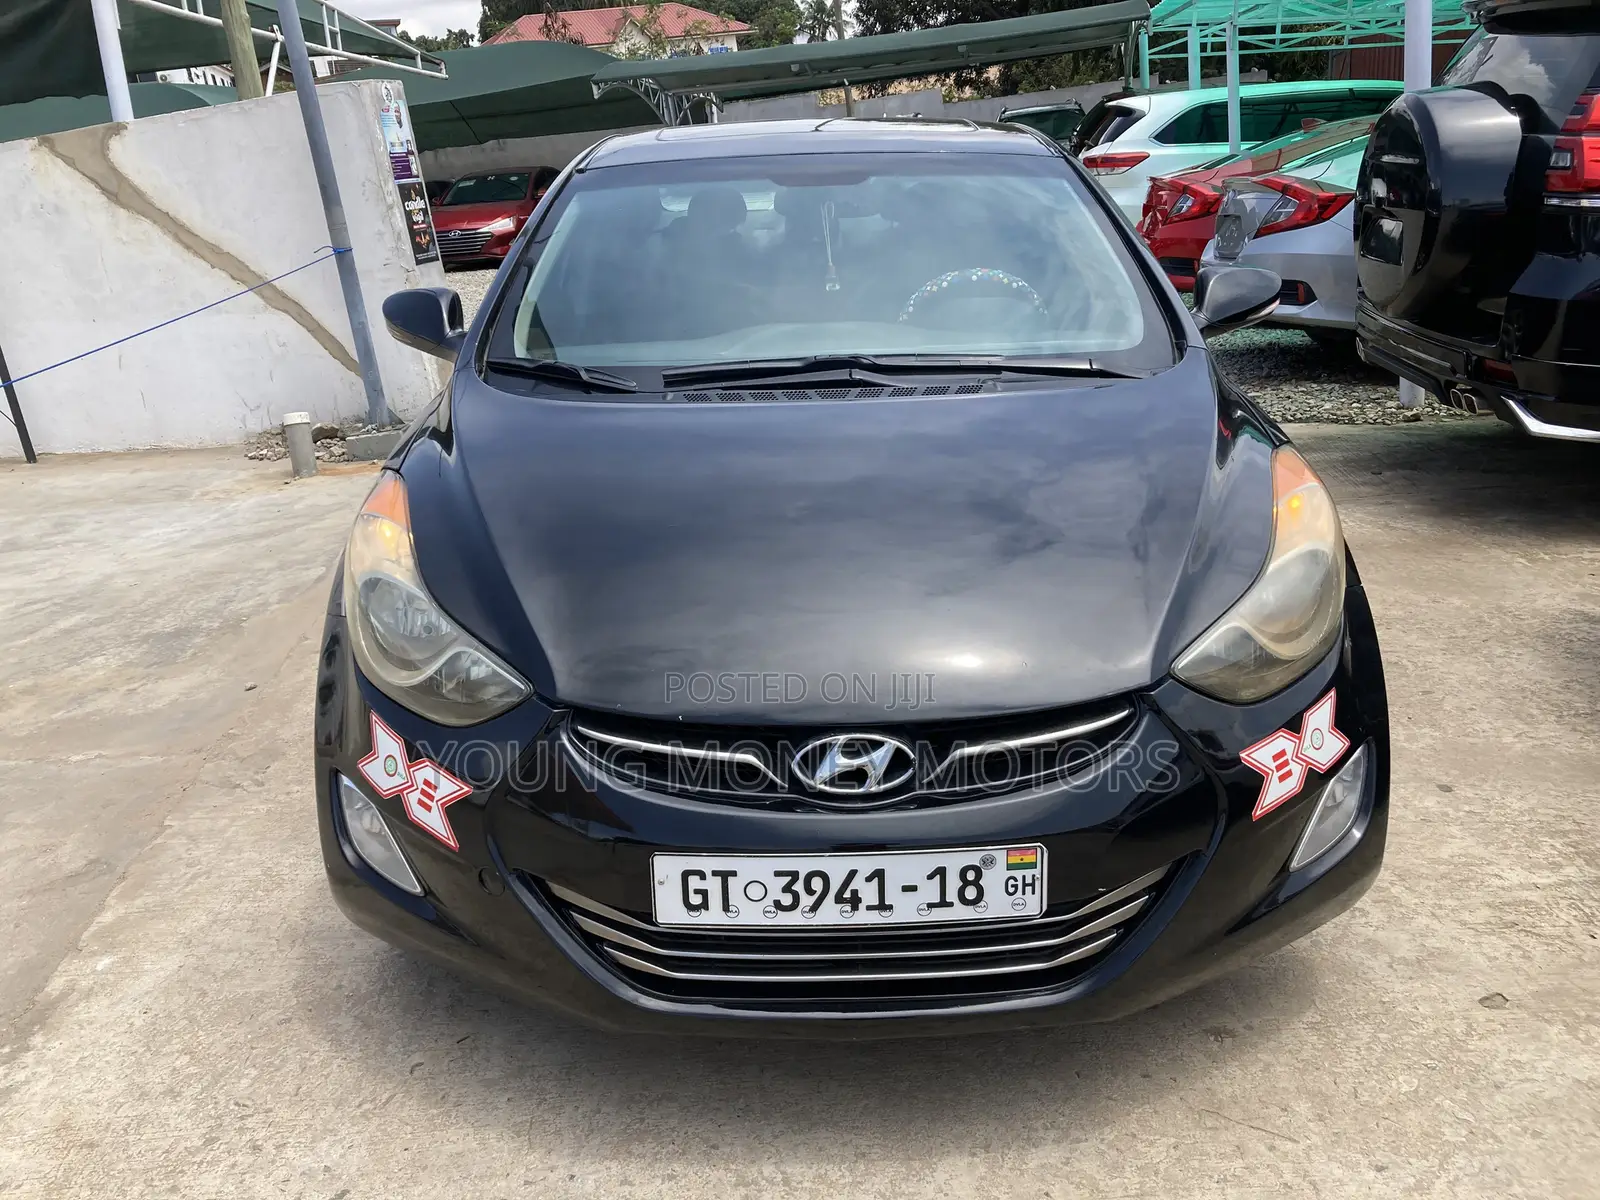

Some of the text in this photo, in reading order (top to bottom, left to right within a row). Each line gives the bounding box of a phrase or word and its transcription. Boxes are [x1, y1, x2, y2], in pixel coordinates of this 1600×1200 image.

[681, 864, 985, 912] GT 3941-18
[1004, 874, 1036, 897] GH
